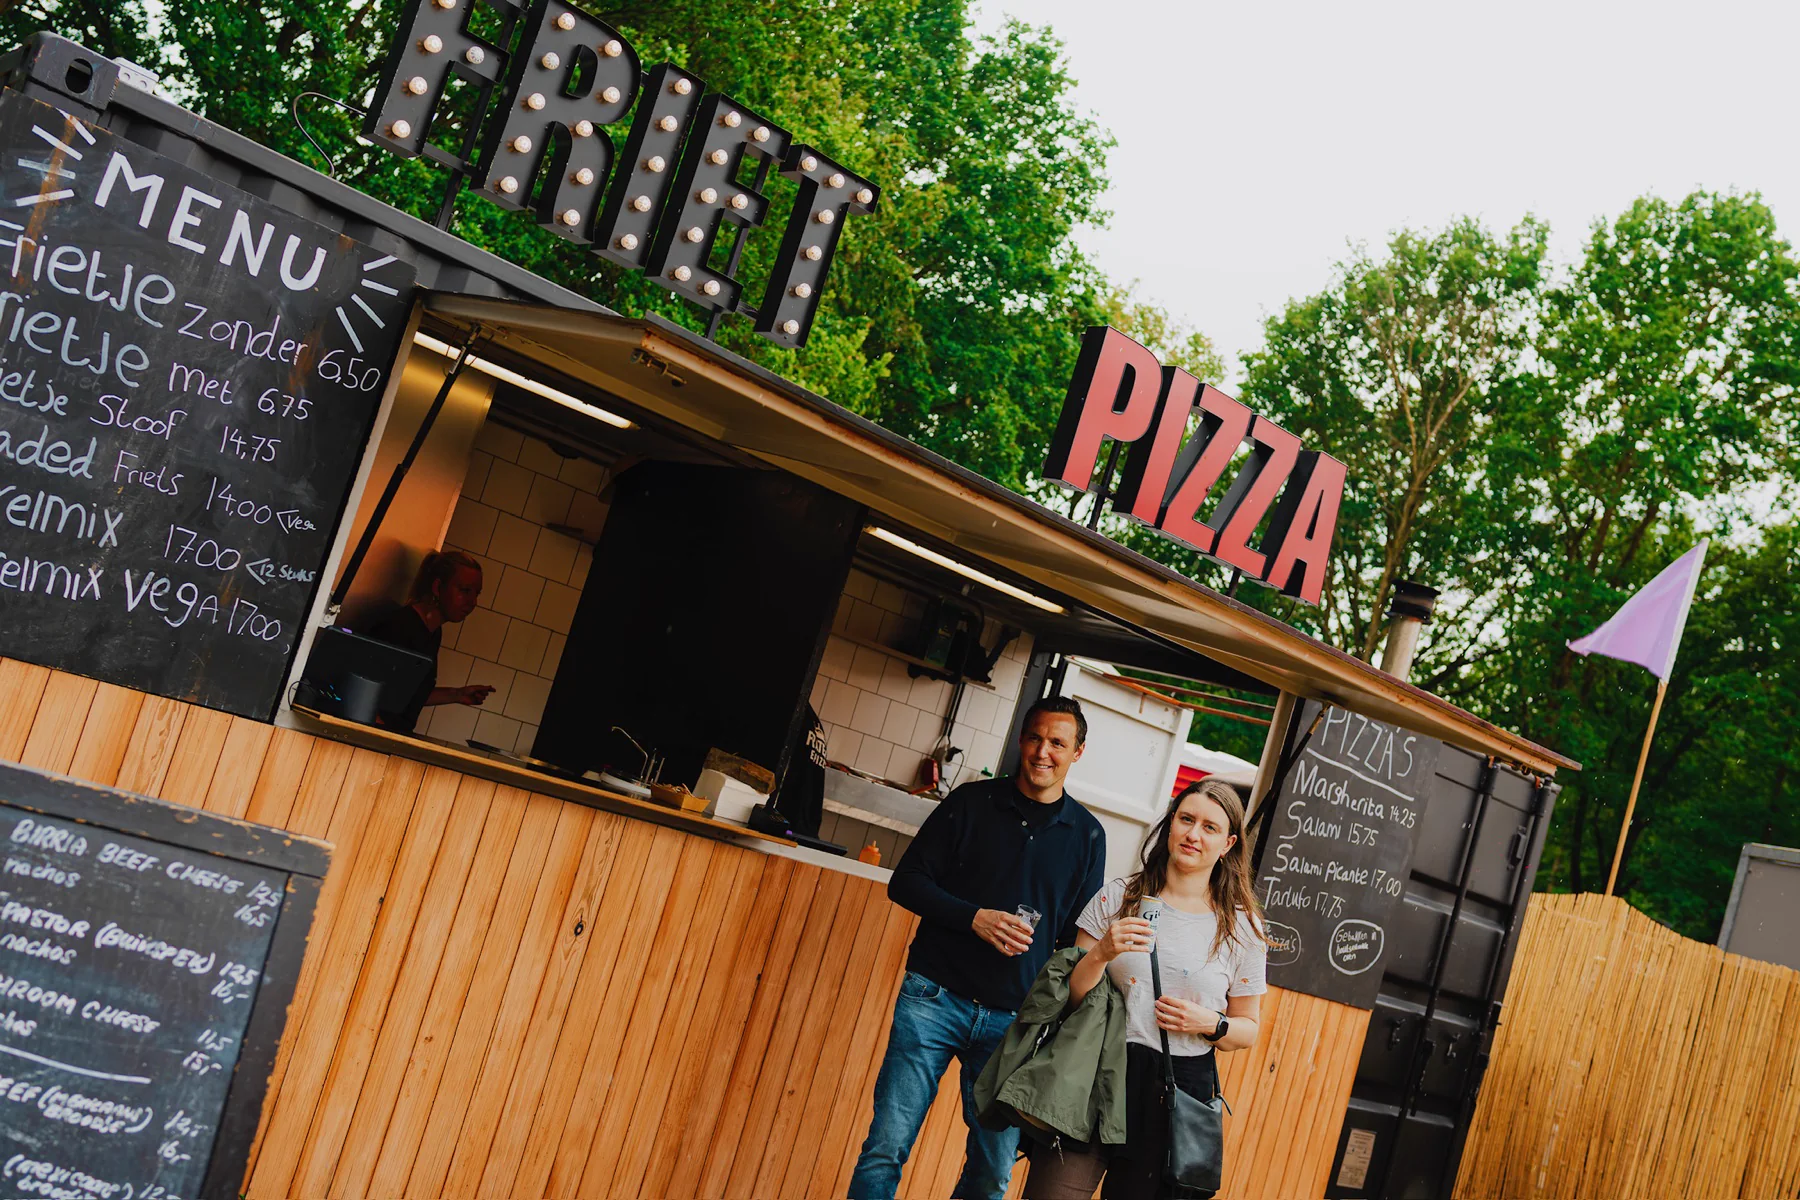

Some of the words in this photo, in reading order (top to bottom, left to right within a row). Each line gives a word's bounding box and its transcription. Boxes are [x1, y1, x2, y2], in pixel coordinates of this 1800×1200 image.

[362, 0, 881, 348] FRIET
[94, 151, 327, 292] MENU
[317, 349, 381, 392] 6,50
[89, 394, 188, 440] Stoof
[219, 426, 282, 462] 14,75
[1042, 325, 1348, 606] PIZZA
[205, 476, 272, 525] 14,00
[0, 551, 104, 601] elmix
[1292, 759, 1384, 819] Margherita
[1279, 800, 1343, 840] Salami
[10, 819, 87, 857] BIRRIA
[97, 842, 159, 872] BEEF
[166, 861, 245, 894] CHEESE
[1272, 843, 1323, 876] Salami
[0, 902, 90, 938] PASTOR
[81, 1001, 161, 1033] CHEESE
